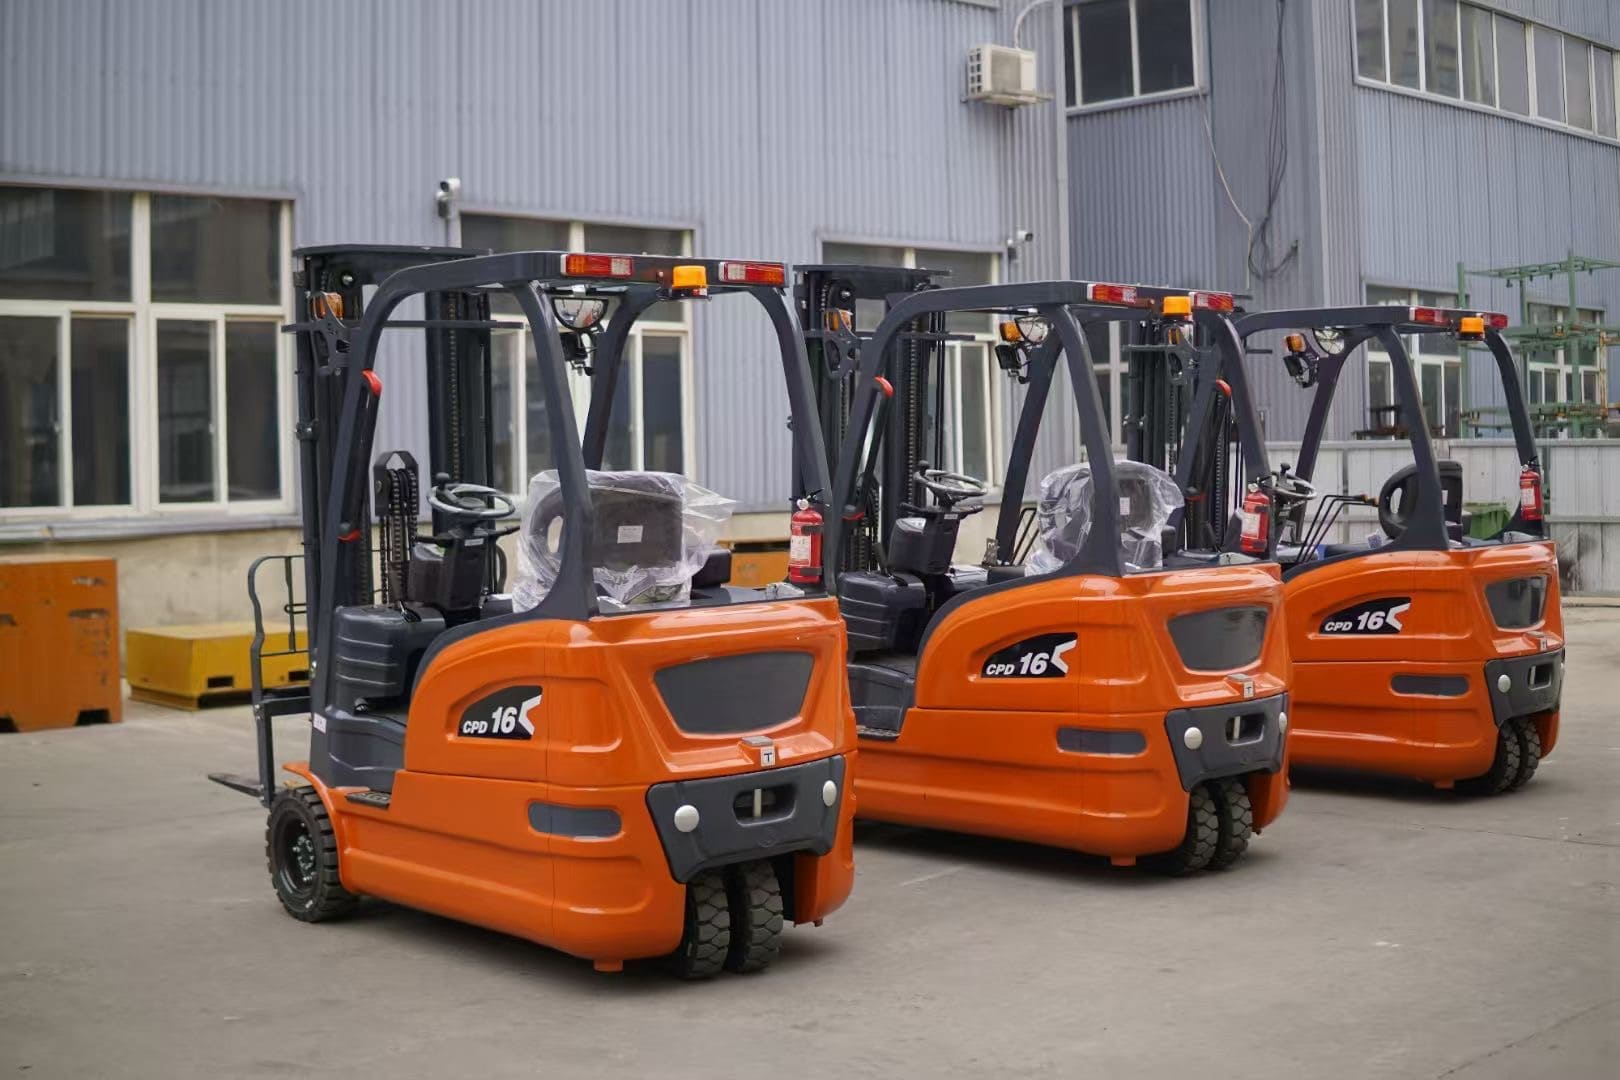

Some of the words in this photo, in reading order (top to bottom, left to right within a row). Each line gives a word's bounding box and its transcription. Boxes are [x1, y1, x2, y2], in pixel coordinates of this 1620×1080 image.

[1324, 621, 1353, 632] CPD
[1357, 611, 1386, 630] 16
[985, 663, 1015, 675] CPD
[1020, 652, 1050, 675] 16
[462, 720, 488, 734] CPD
[491, 706, 518, 734] 16
[763, 752, 773, 763] T
